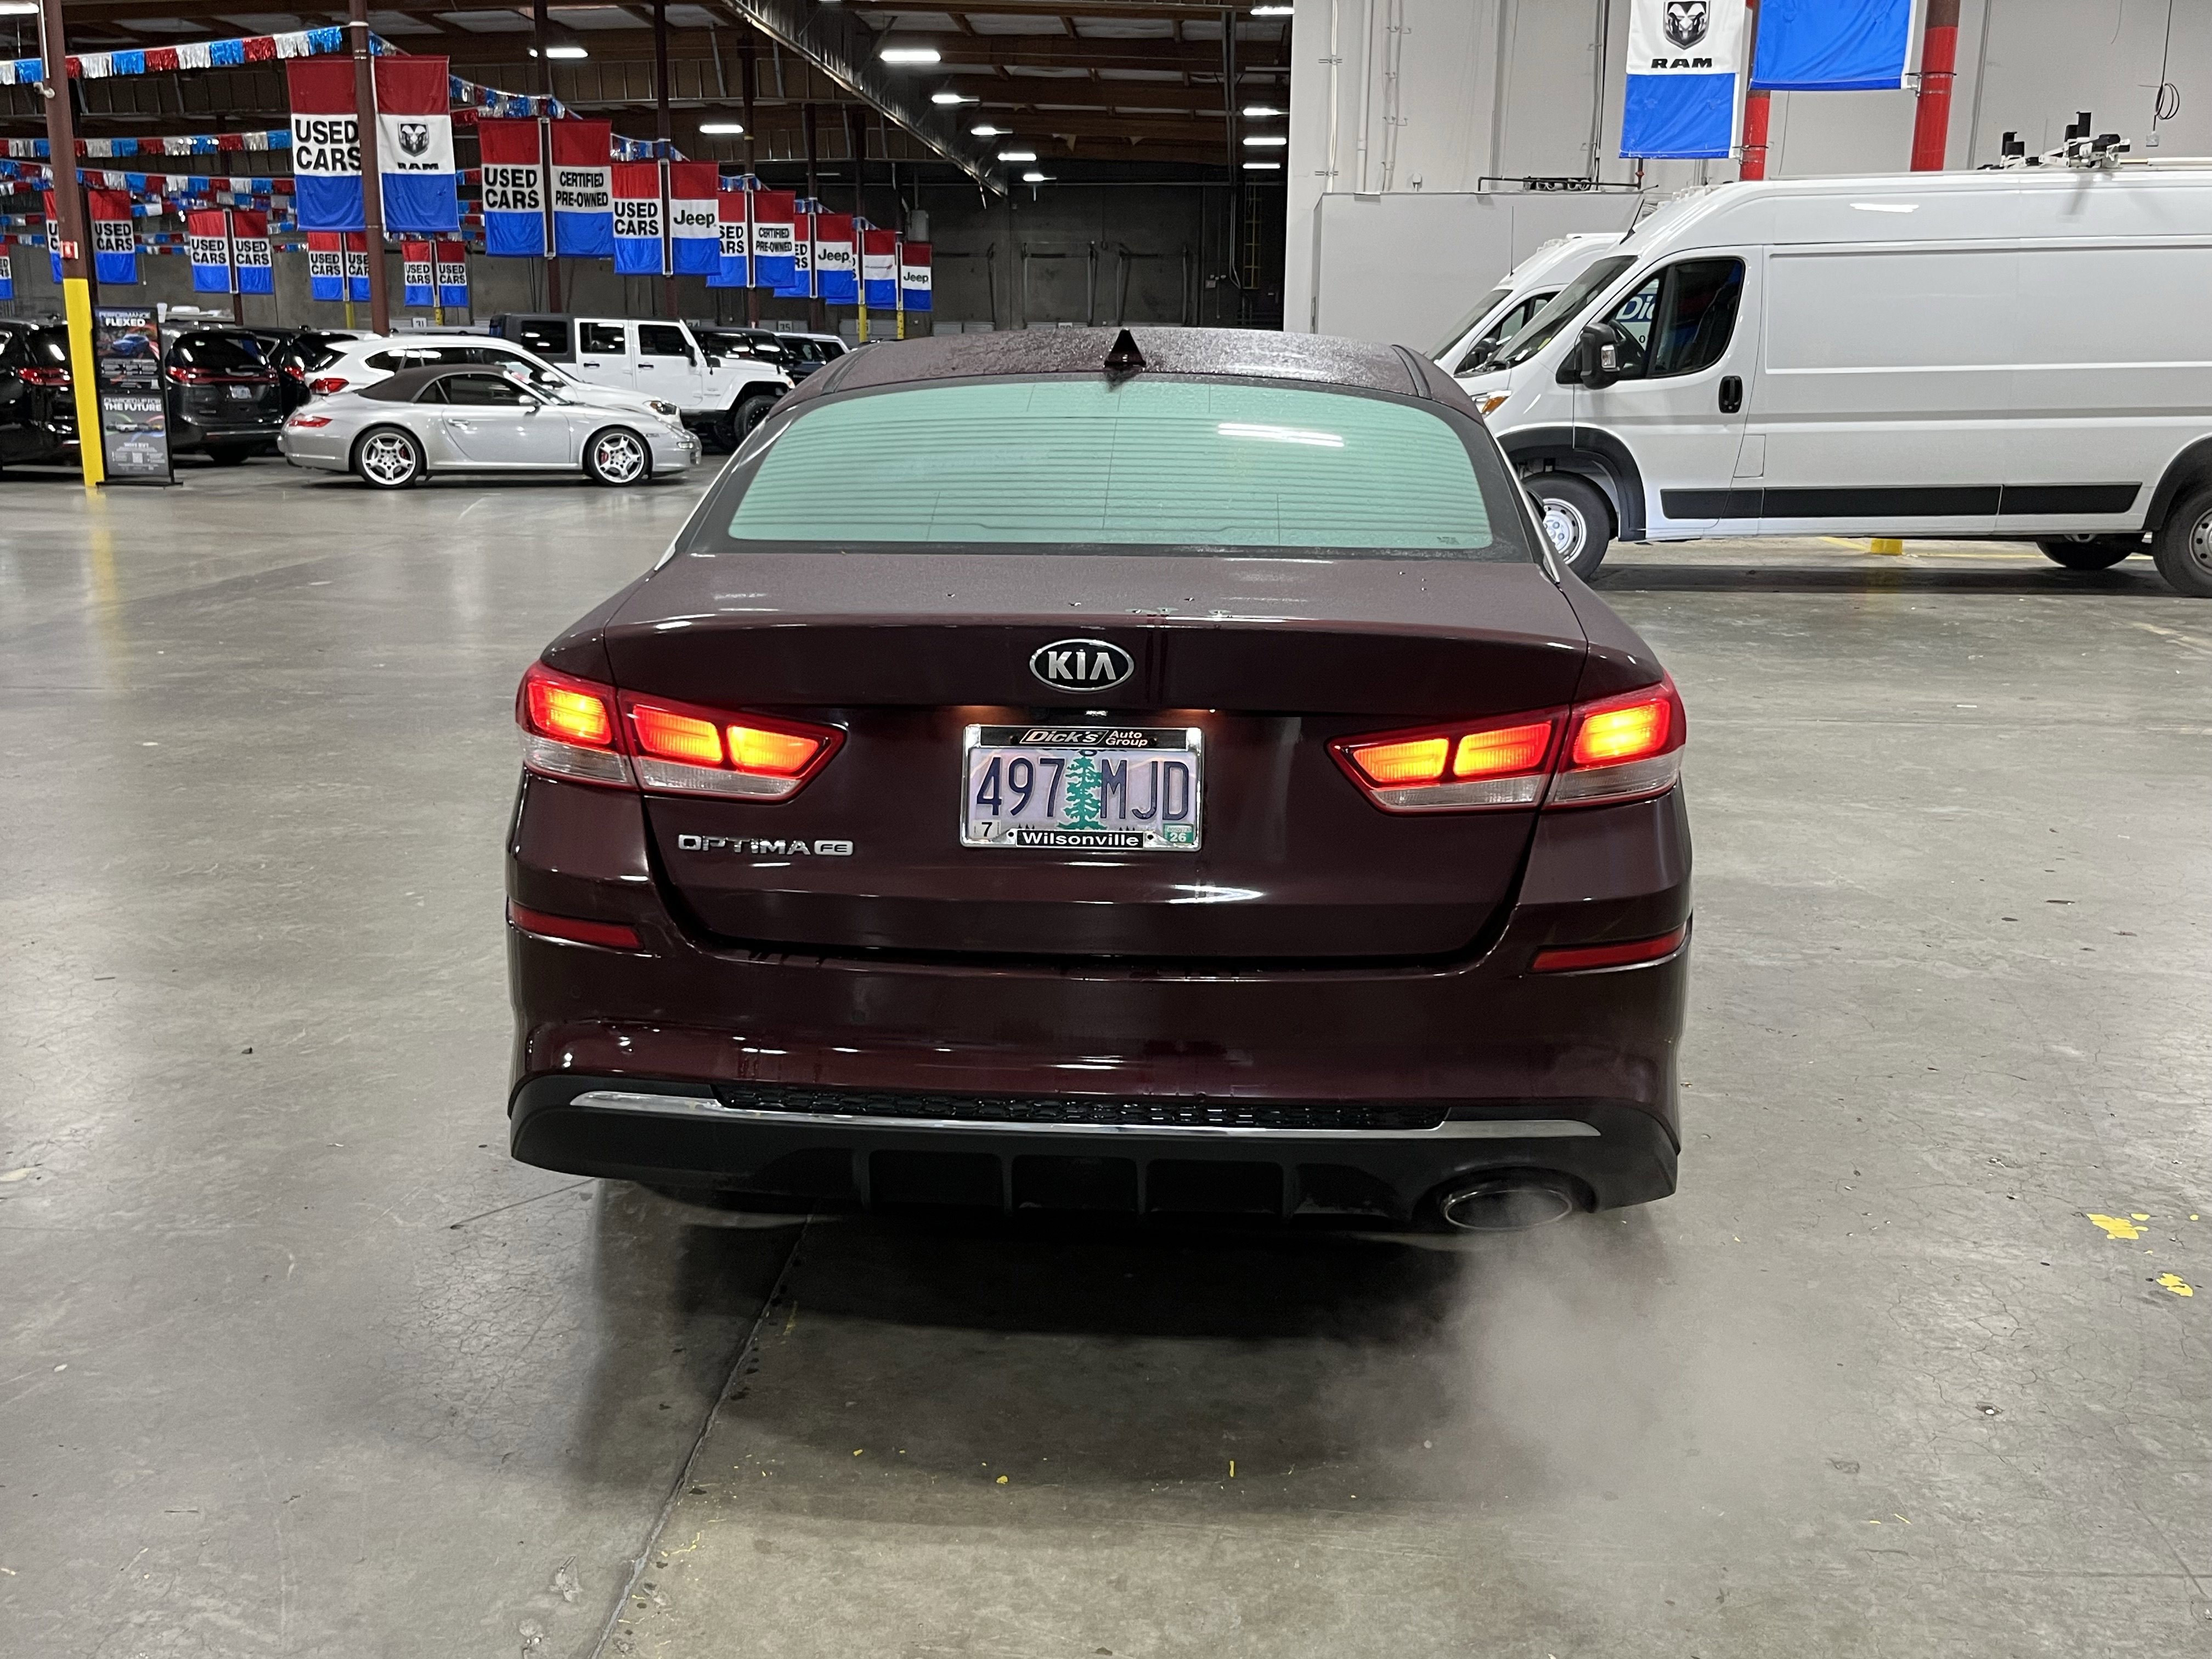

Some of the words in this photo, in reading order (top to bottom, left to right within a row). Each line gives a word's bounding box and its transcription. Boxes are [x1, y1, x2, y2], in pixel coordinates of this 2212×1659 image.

[1651, 58, 1712, 69] RAM
[295, 119, 359, 145] USED
[296, 146, 362, 171] CARS
[484, 167, 537, 188] USED
[560, 171, 603, 188] CERTIFIED
[485, 189, 540, 209] CARS
[555, 192, 608, 207] PRE-OWNED
[614, 202, 658, 218] USED
[673, 210, 715, 228] Jeep
[94, 223, 131, 236] USED
[614, 220, 659, 235] CARS
[719, 225, 743, 239] SED
[759, 227, 789, 238] CERTIFIED
[96, 237, 133, 251] CARS
[191, 239, 224, 252] USED
[236, 240, 267, 252] USED
[719, 240, 744, 254] ARS
[755, 241, 792, 252] PRE-OWNED
[795, 244, 808, 256] ED
[192, 252, 227, 264] CARS
[236, 253, 269, 265] CARS
[311, 253, 340, 263] USED
[348, 254, 368, 264] USE
[818, 249, 850, 263] Jeep
[312, 265, 341, 275] CARS
[348, 266, 369, 276] CAR
[406, 264, 430, 274] USED
[439, 264, 465, 274] USED
[406, 274, 431, 284] CARS
[439, 274, 466, 284] CARS
[904, 272, 929, 284] Jeep
[105, 318, 146, 327] FLEXED
[125, 403, 162, 411] FUTURE
[1048, 651, 1116, 680] KIA
[1026, 731, 1098, 742] Dick's
[1106, 738, 1148, 747] Group
[977, 757, 1065, 816] 497
[1099, 759, 1189, 820] MJD
[981, 822, 992, 837] 7
[1022, 832, 1139, 847] Wilsonville
[1170, 832, 1186, 842] 26
[678, 834, 811, 855] OPTIMA
[820, 844, 848, 852] FE
